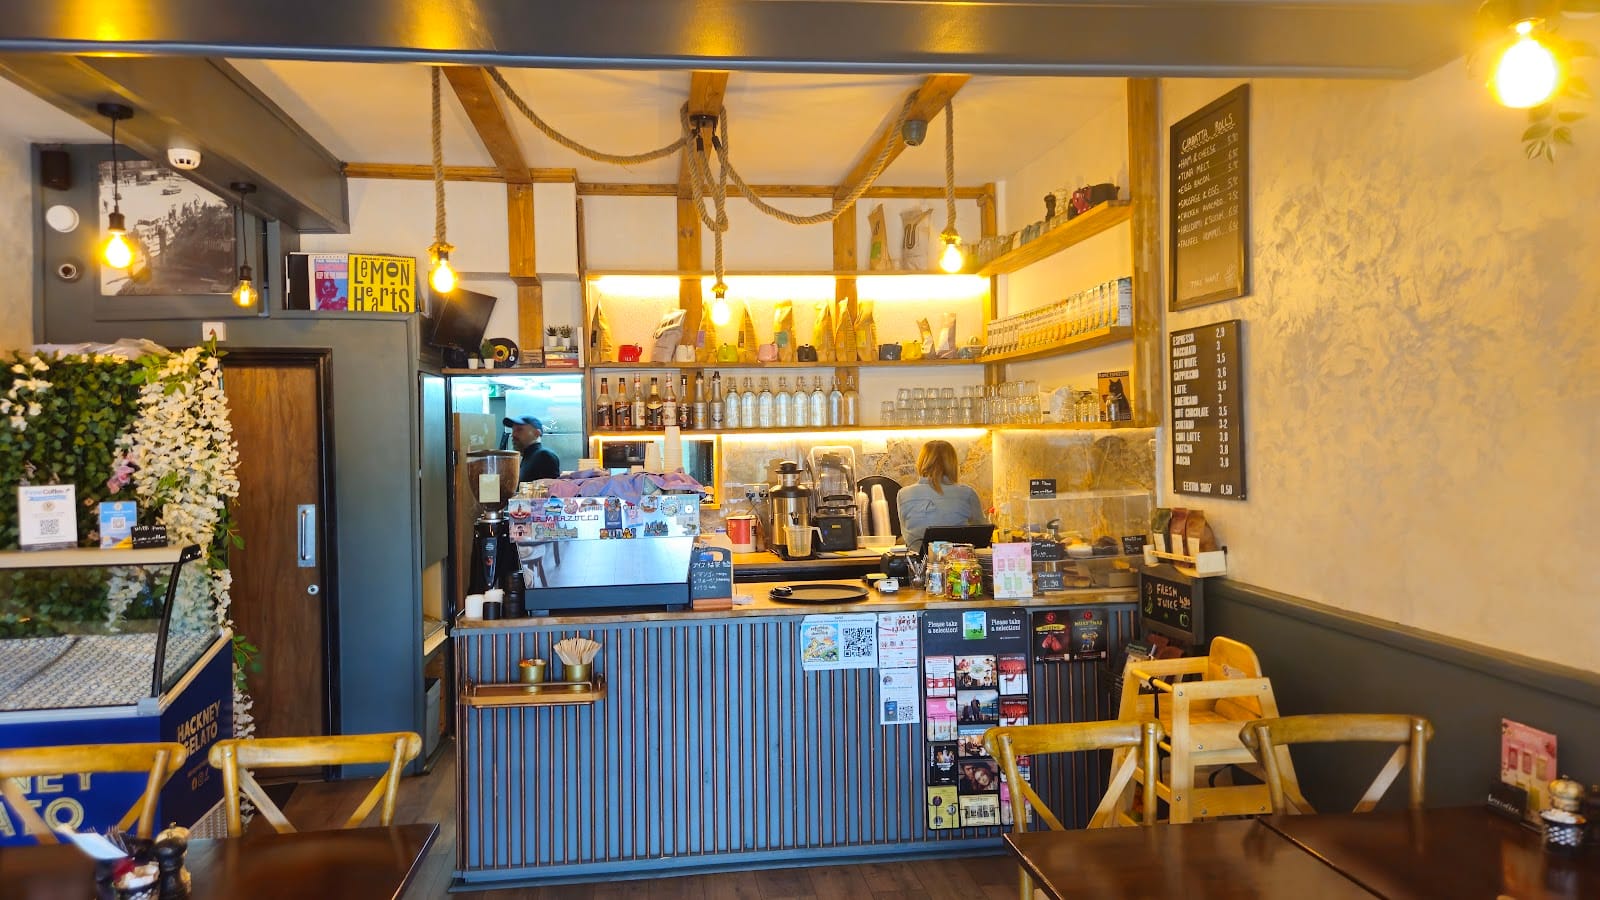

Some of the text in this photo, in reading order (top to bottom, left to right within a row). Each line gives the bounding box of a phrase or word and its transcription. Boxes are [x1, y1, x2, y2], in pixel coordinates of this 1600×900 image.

[1216, 340, 1221, 351] 3
[1174, 384, 1188, 395] LATTE
[1218, 393, 1223, 404] 3
[1185, 406, 1210, 418] CHOCOLATE
[1186, 432, 1201, 442] LATTE
[1156, 583, 1178, 598] FRESH
[1157, 597, 1178, 611] JUICE
[177, 700, 221, 743] HACKNEY
